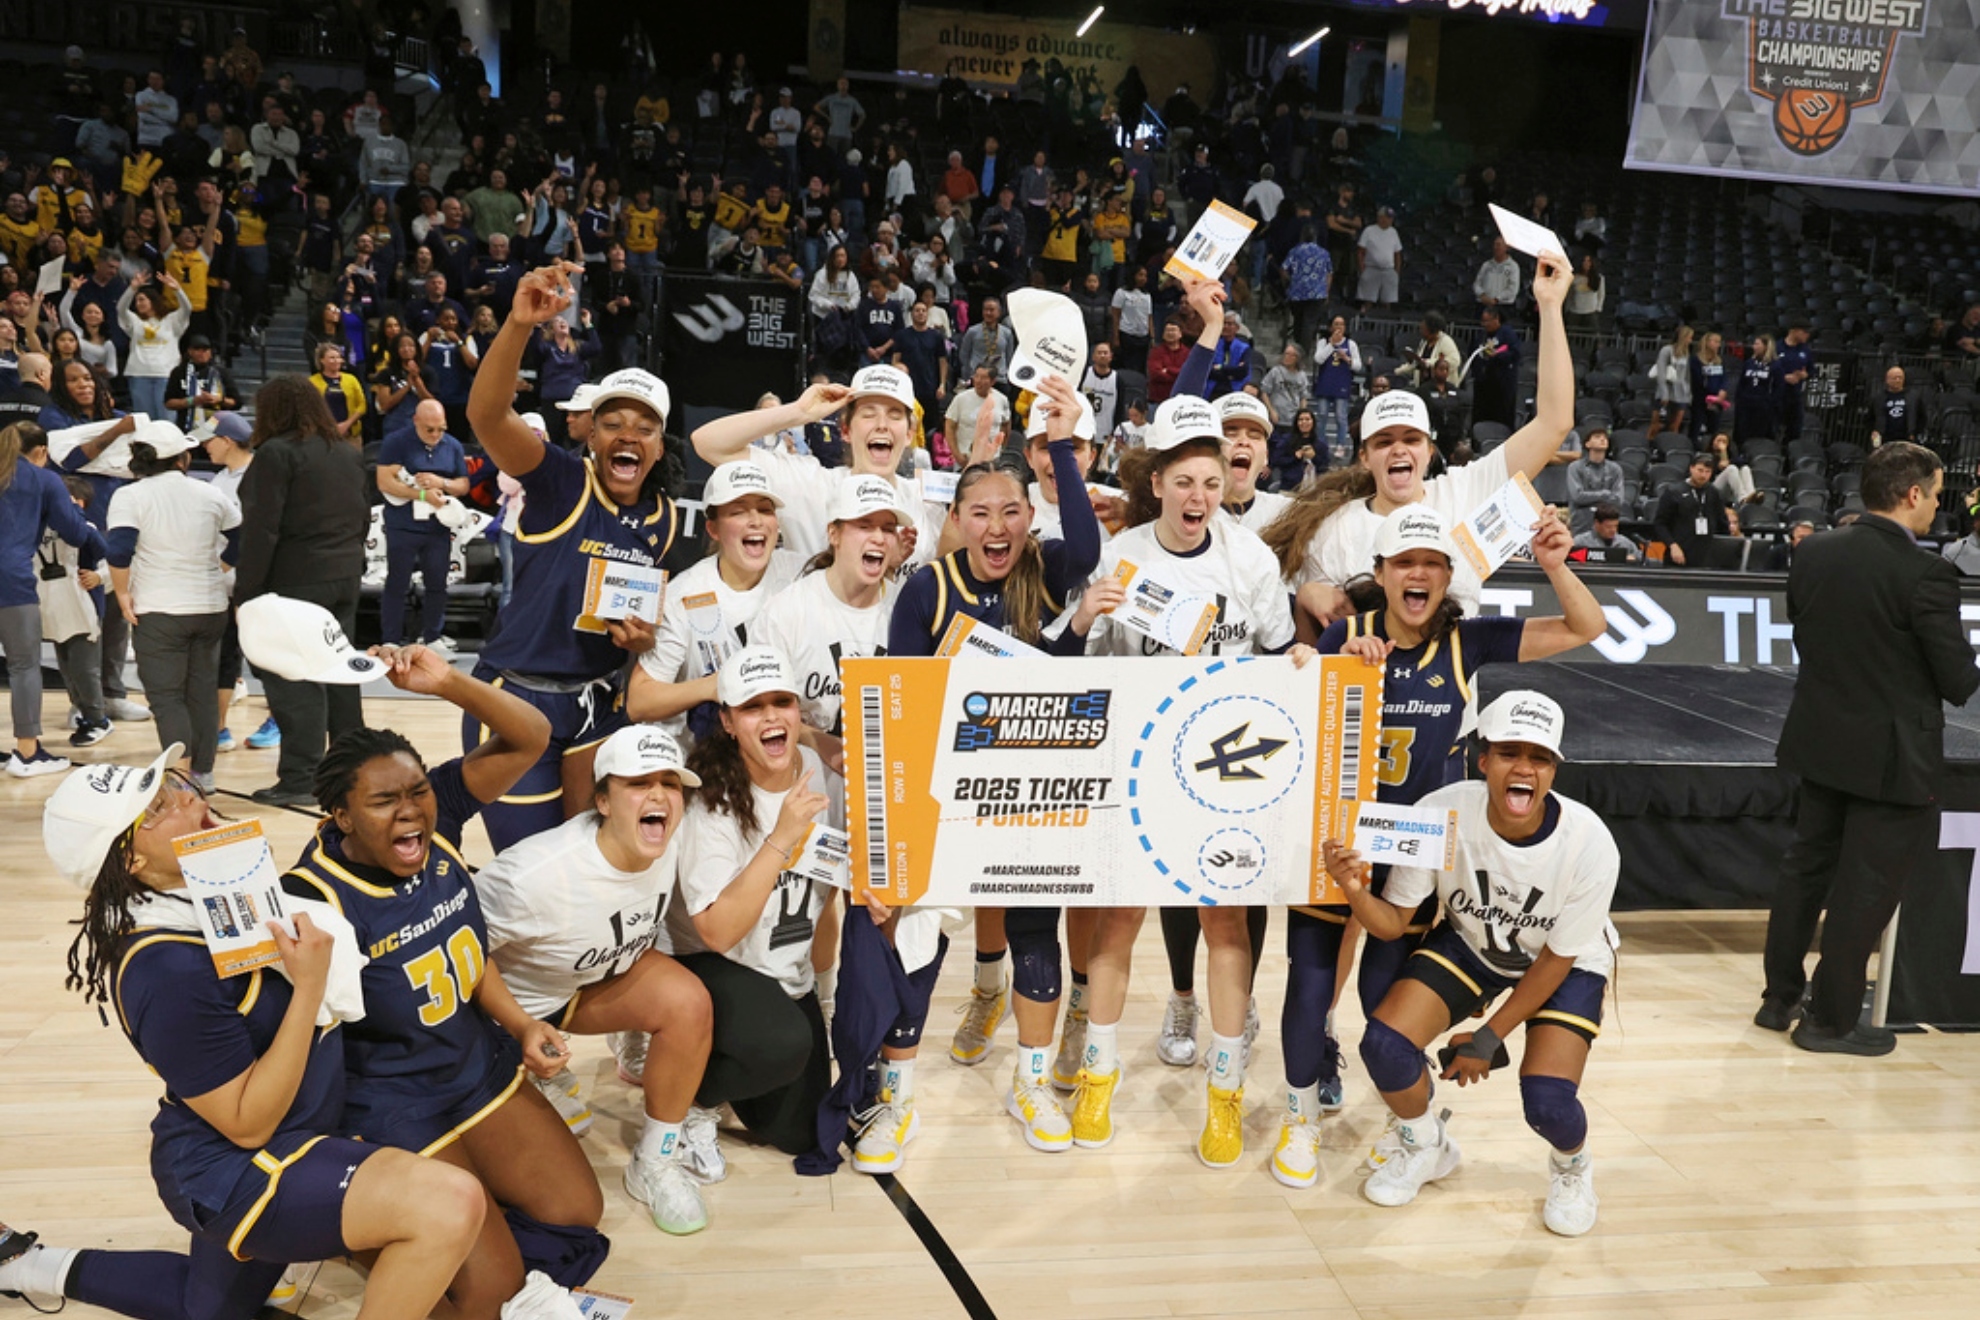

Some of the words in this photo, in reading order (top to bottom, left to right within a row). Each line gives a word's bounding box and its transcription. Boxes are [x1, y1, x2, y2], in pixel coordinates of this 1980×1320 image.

[1790, 0, 1842, 21] BIG
[1845, 0, 1922, 28] WEST
[938, 25, 1020, 55] always
[1026, 33, 1122, 61] advance.
[1757, 19, 1886, 49] BASKETBALL
[1757, 39, 1882, 73] CHAMPIONSHIPS
[1782, 75, 1813, 88] Credit
[183, 267, 191, 283] 1
[748, 295, 787, 315] THE
[869, 309, 895, 325] GAP
[747, 312, 783, 332] BIG
[746, 330, 798, 349] WEST
[442, 350, 451, 368] 1
[890, 692, 902, 720] SEAT
[989, 695, 1069, 718] MARCH
[1325, 670, 1338, 731] QUALIFIER
[998, 718, 1107, 741] MADNESS
[1320, 733, 1335, 797] AUTOMATIC
[893, 777, 905, 804] ROW
[954, 777, 1022, 801] 2025
[1028, 777, 1112, 801] TICKET
[975, 803, 1090, 828] PUNCHED
[896, 852, 908, 899] SECTION
[982, 865, 1081, 876] #MARCHMADNESS
[1448, 887, 1557, 932] Champions
[402, 924, 485, 1027] 30
